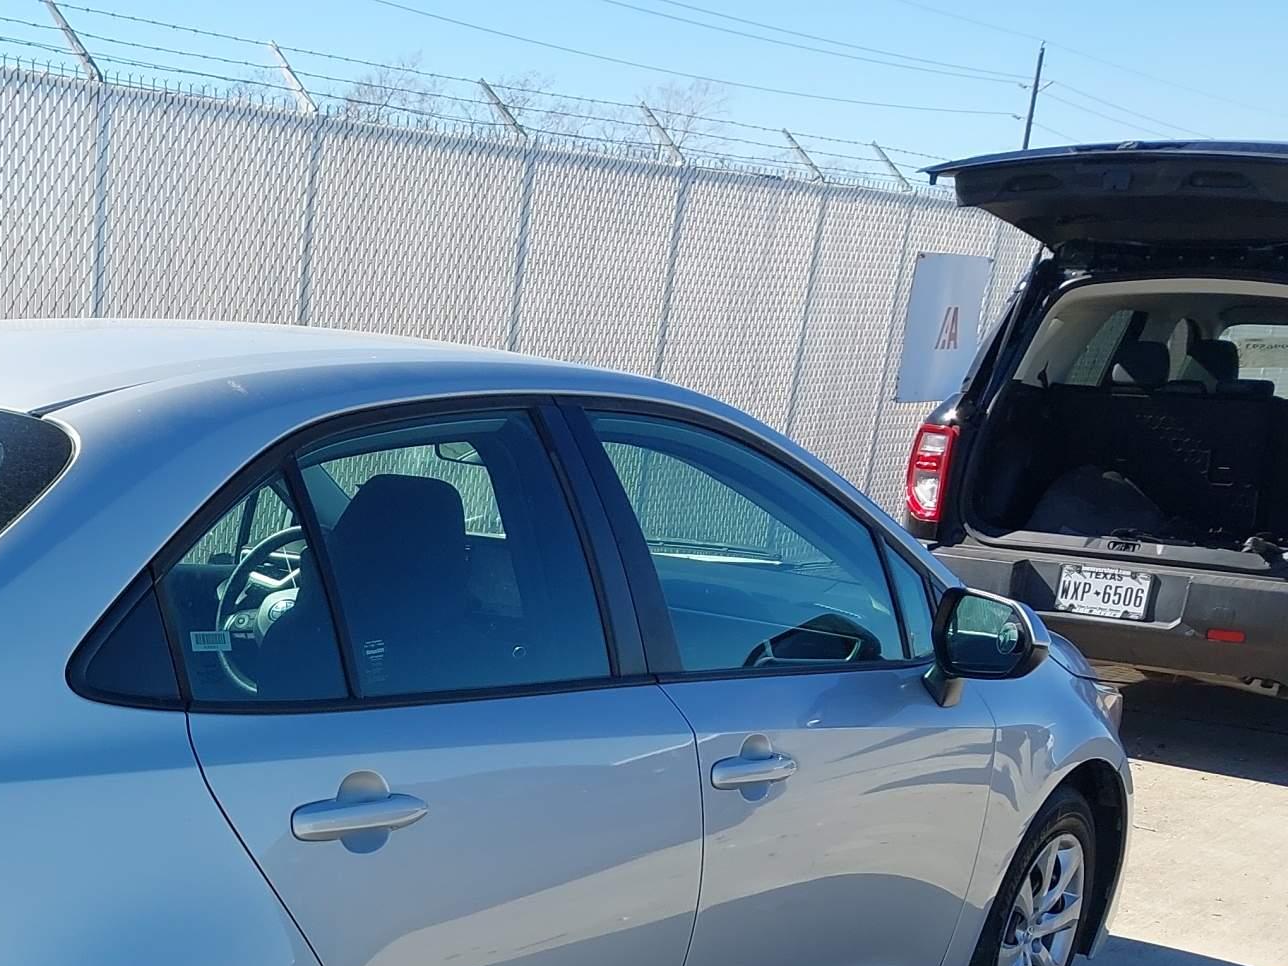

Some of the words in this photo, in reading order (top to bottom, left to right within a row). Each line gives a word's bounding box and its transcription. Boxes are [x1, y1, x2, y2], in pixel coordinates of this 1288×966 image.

[1089, 570, 1124, 582] TEXAS
[1060, 579, 1092, 602] WXP
[1101, 584, 1145, 608] 6506
